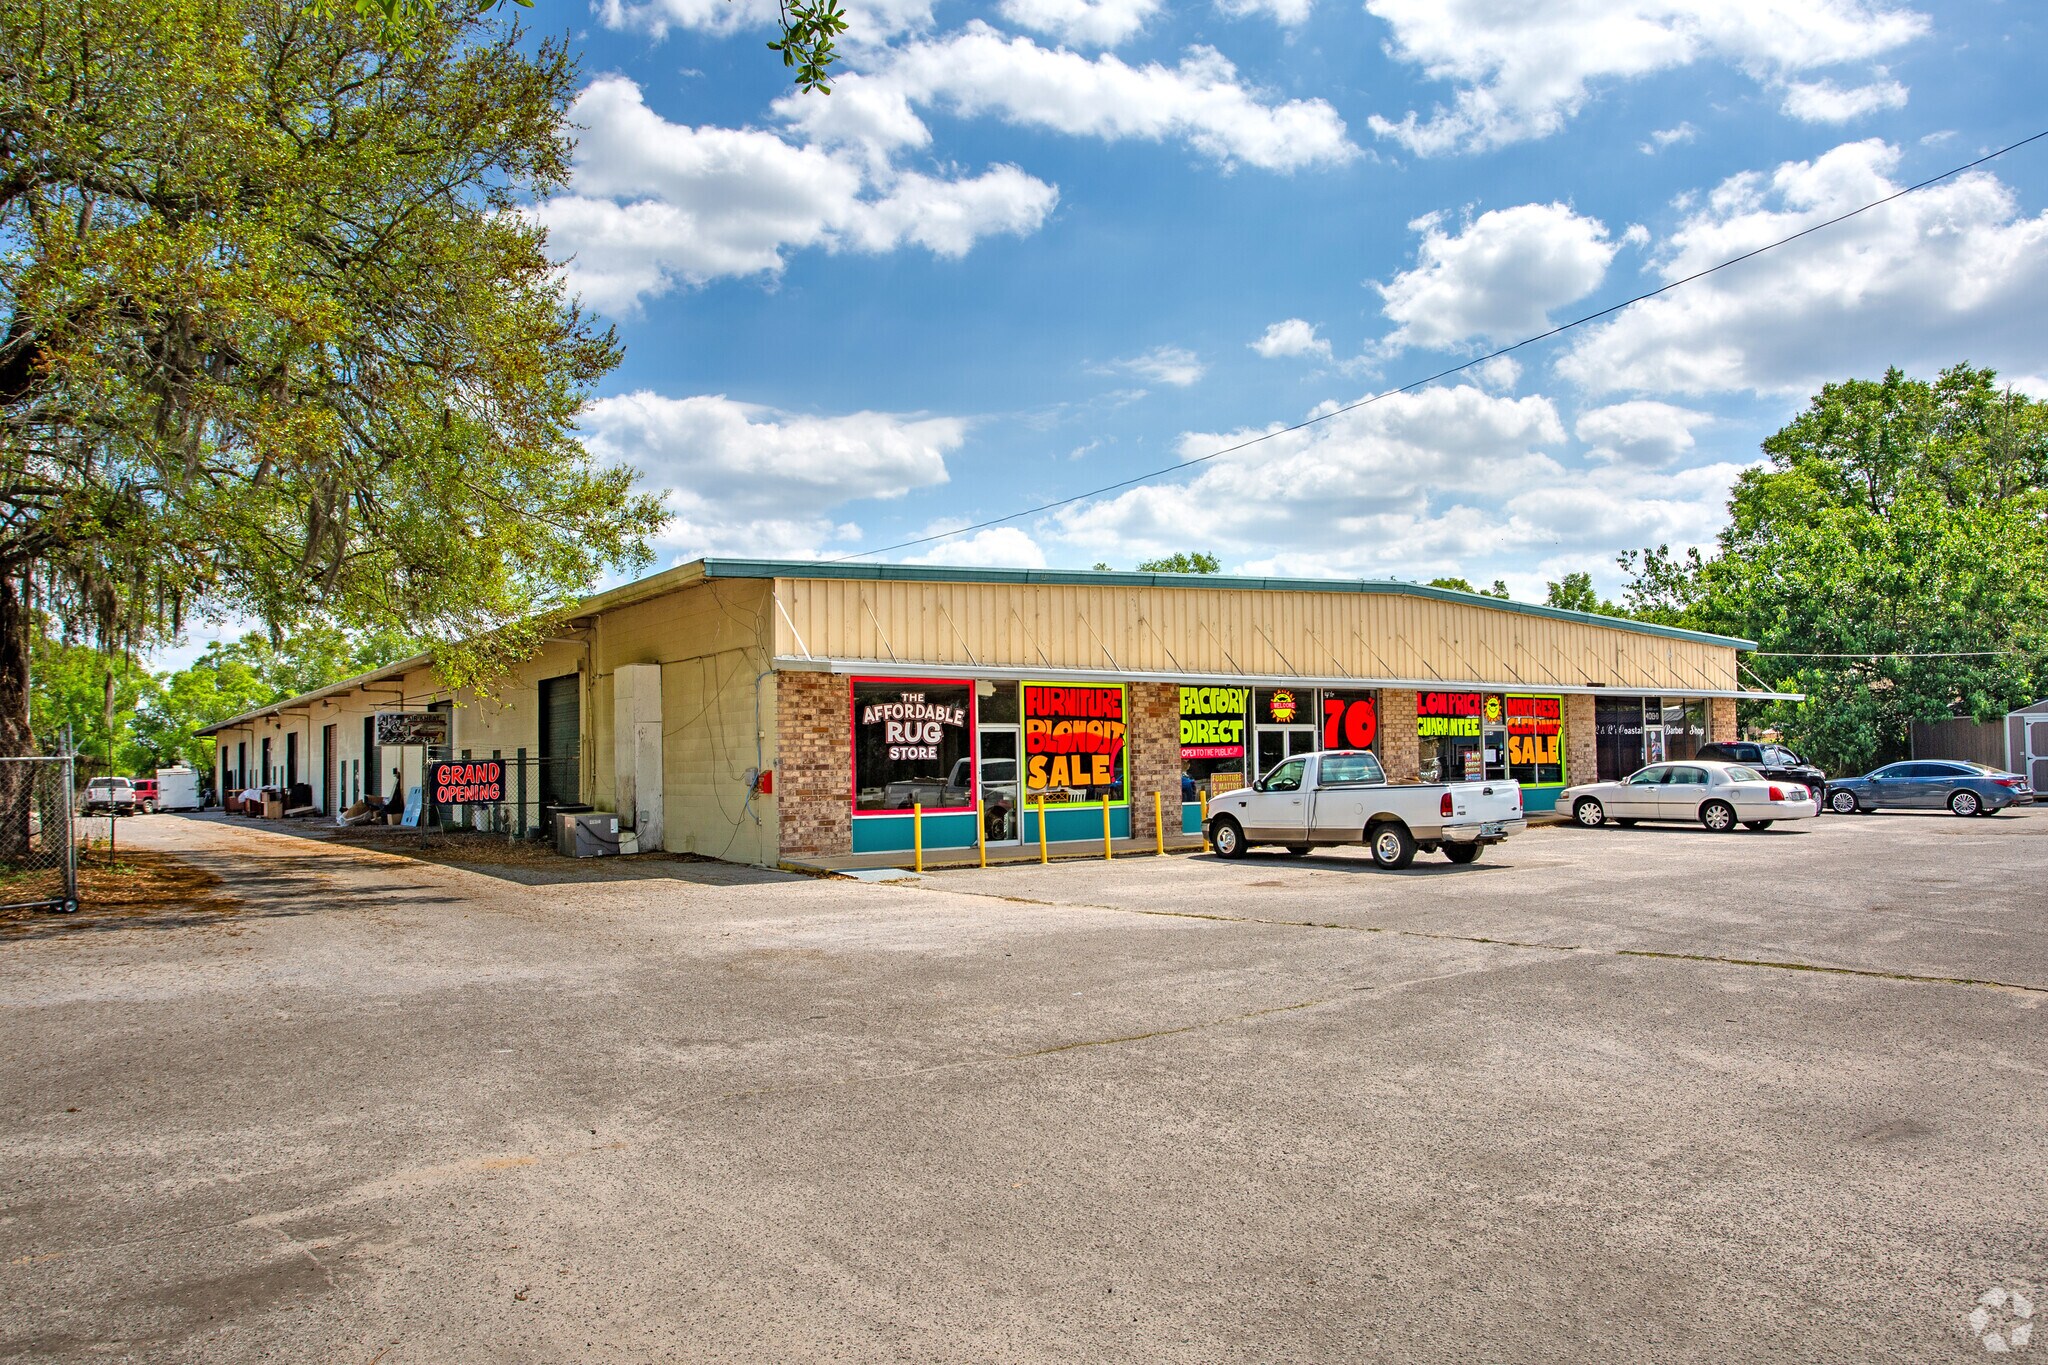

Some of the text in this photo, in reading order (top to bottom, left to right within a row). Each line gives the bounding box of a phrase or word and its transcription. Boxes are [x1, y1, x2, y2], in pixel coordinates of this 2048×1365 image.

[901, 693, 925, 702] THE
[1025, 687, 1121, 718] FURNITURE
[1180, 687, 1250, 714] FACTORY
[1448, 693, 1481, 715] PRICE
[862, 702, 965, 727] AFFORDABLE
[1507, 698, 1560, 719] MATTRESS
[886, 721, 943, 744] RUG
[1180, 720, 1244, 744] DIRECT
[1417, 717, 1480, 736] GUARANTEE
[1618, 724, 1643, 735] Coastal
[1664, 724, 1684, 735] Barber
[1689, 724, 1705, 736] Shop
[889, 746, 938, 760] STORE
[1181, 749, 1196, 757] OPEN
[437, 763, 500, 785] GRAND
[1212, 773, 1242, 782] FURNITURE
[437, 783, 500, 803] OPENING
